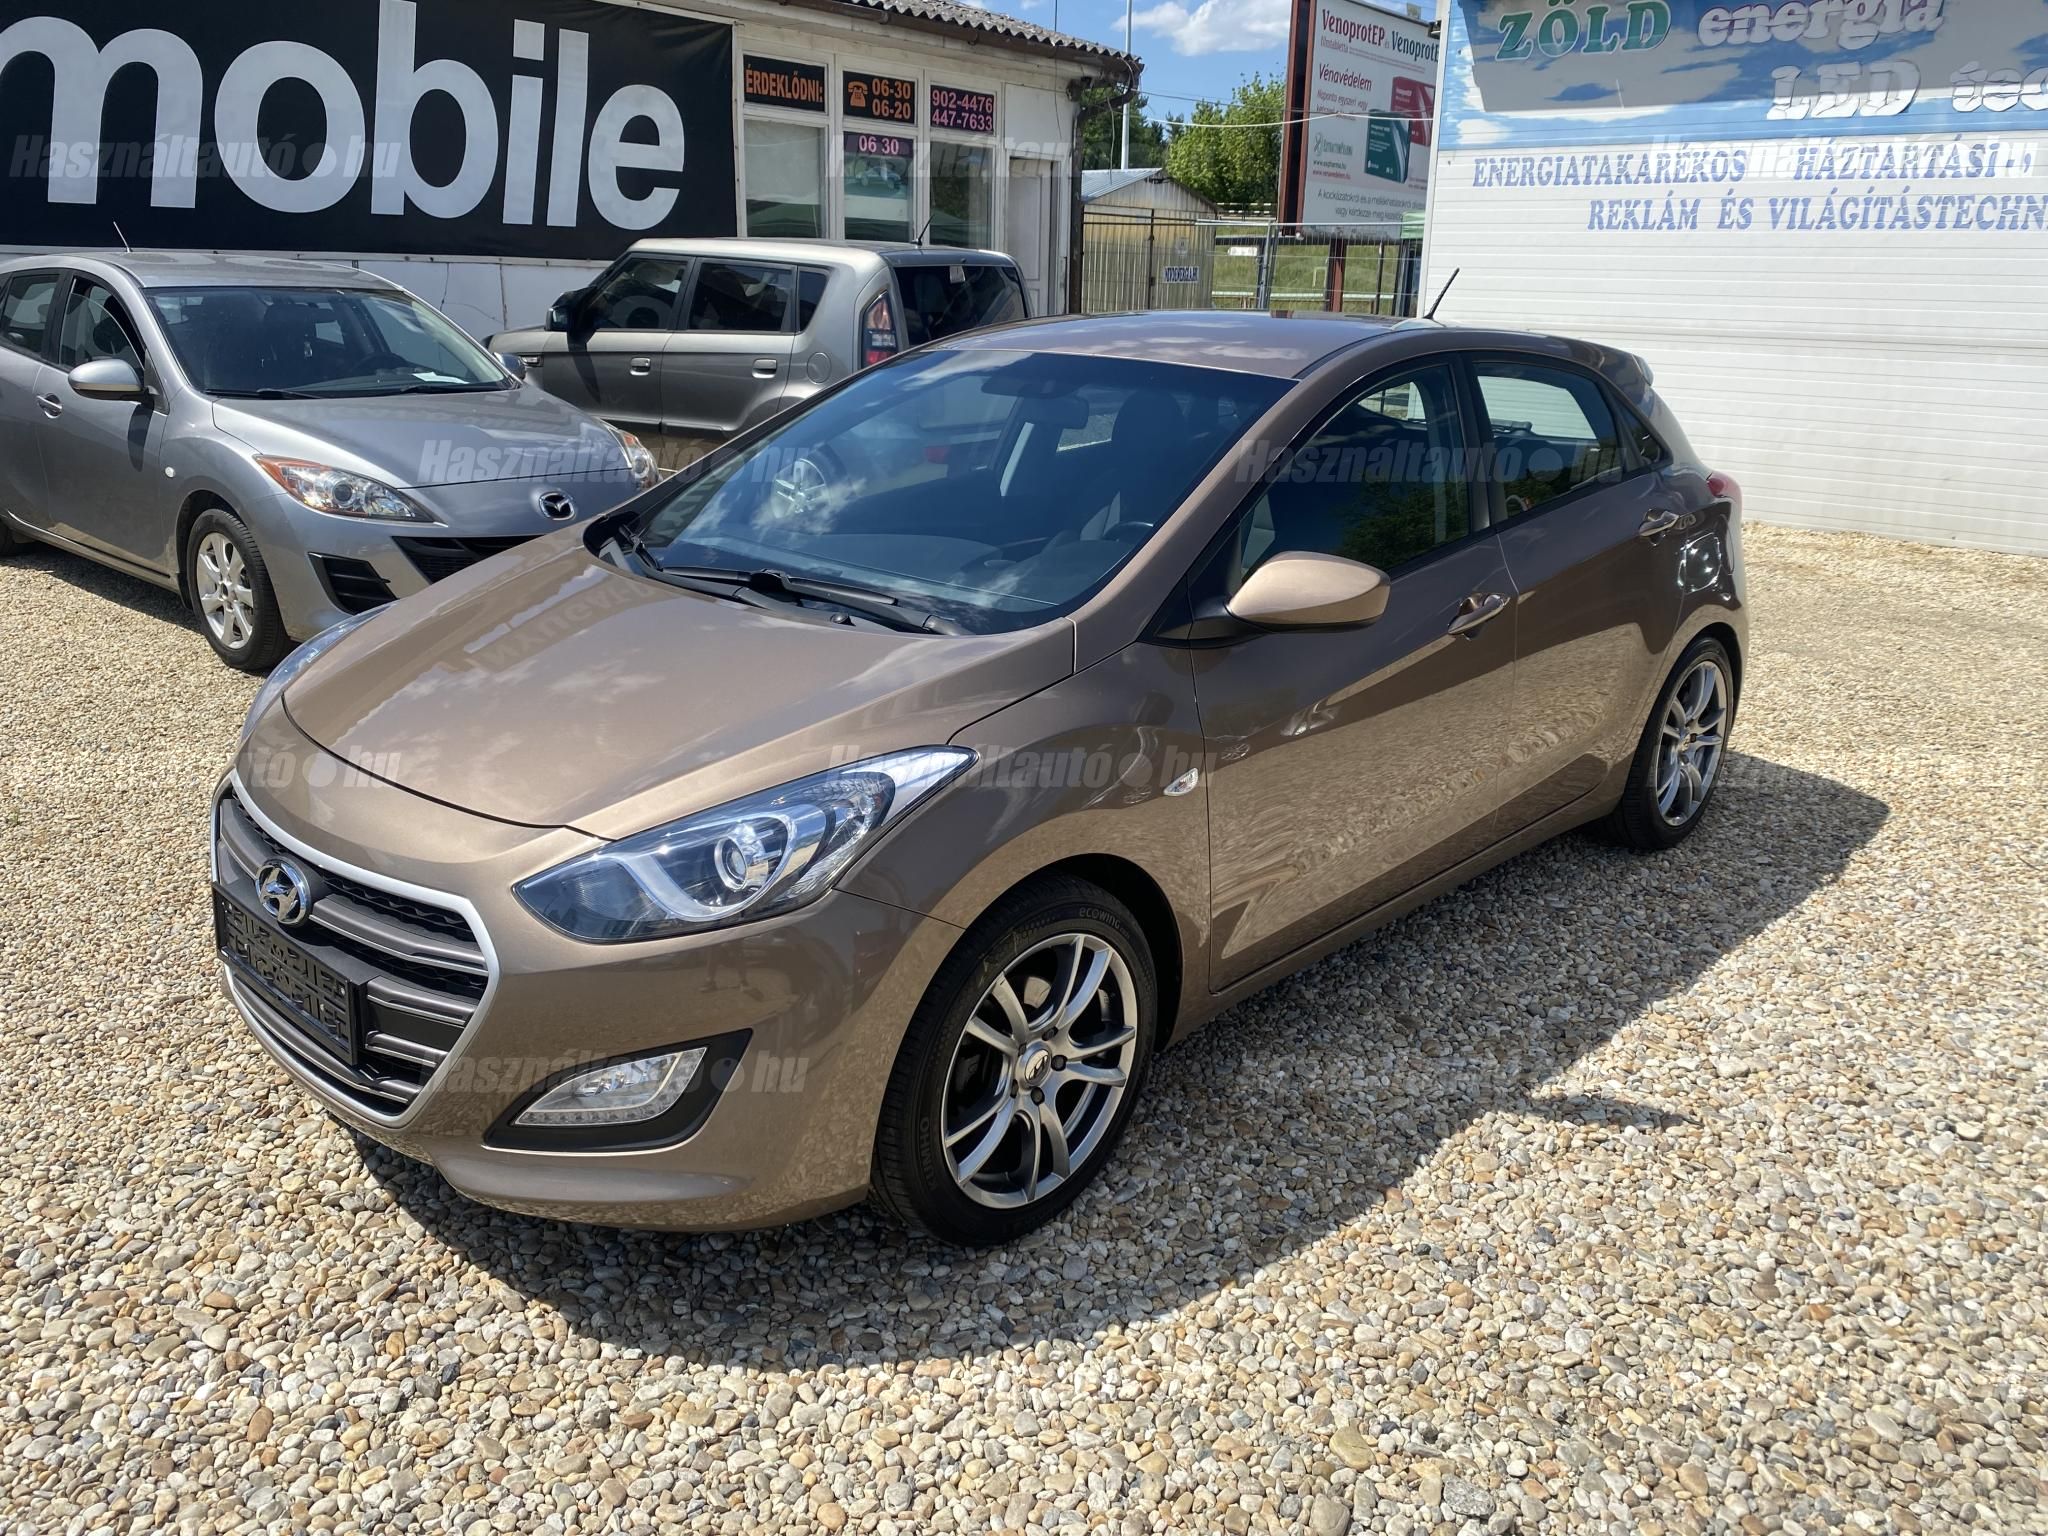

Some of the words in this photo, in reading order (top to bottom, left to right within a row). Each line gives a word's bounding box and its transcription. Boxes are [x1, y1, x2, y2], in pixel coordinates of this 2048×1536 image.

[1322, 9, 1385, 46] VenoprotEP
[1495, 0, 1671, 61] ZÖLD
[745, 64, 823, 102] ÉRDEKLŐDNI:
[872, 78, 911, 99] 06-30
[932, 90, 994, 113] 902-4476
[1319, 64, 1372, 91] Vénavédelem
[1767, 60, 1921, 120] LED
[0, 0, 685, 231] mobile
[872, 99, 911, 120] 06-20
[932, 108, 994, 132] 447-7633
[858, 135, 877, 153] 06
[882, 138, 899, 155] 30
[1473, 143, 1747, 187] ENERGIATAKARÉKOS
[1587, 190, 1700, 230] REKLÁM
[1717, 188, 1754, 230] ÉS
